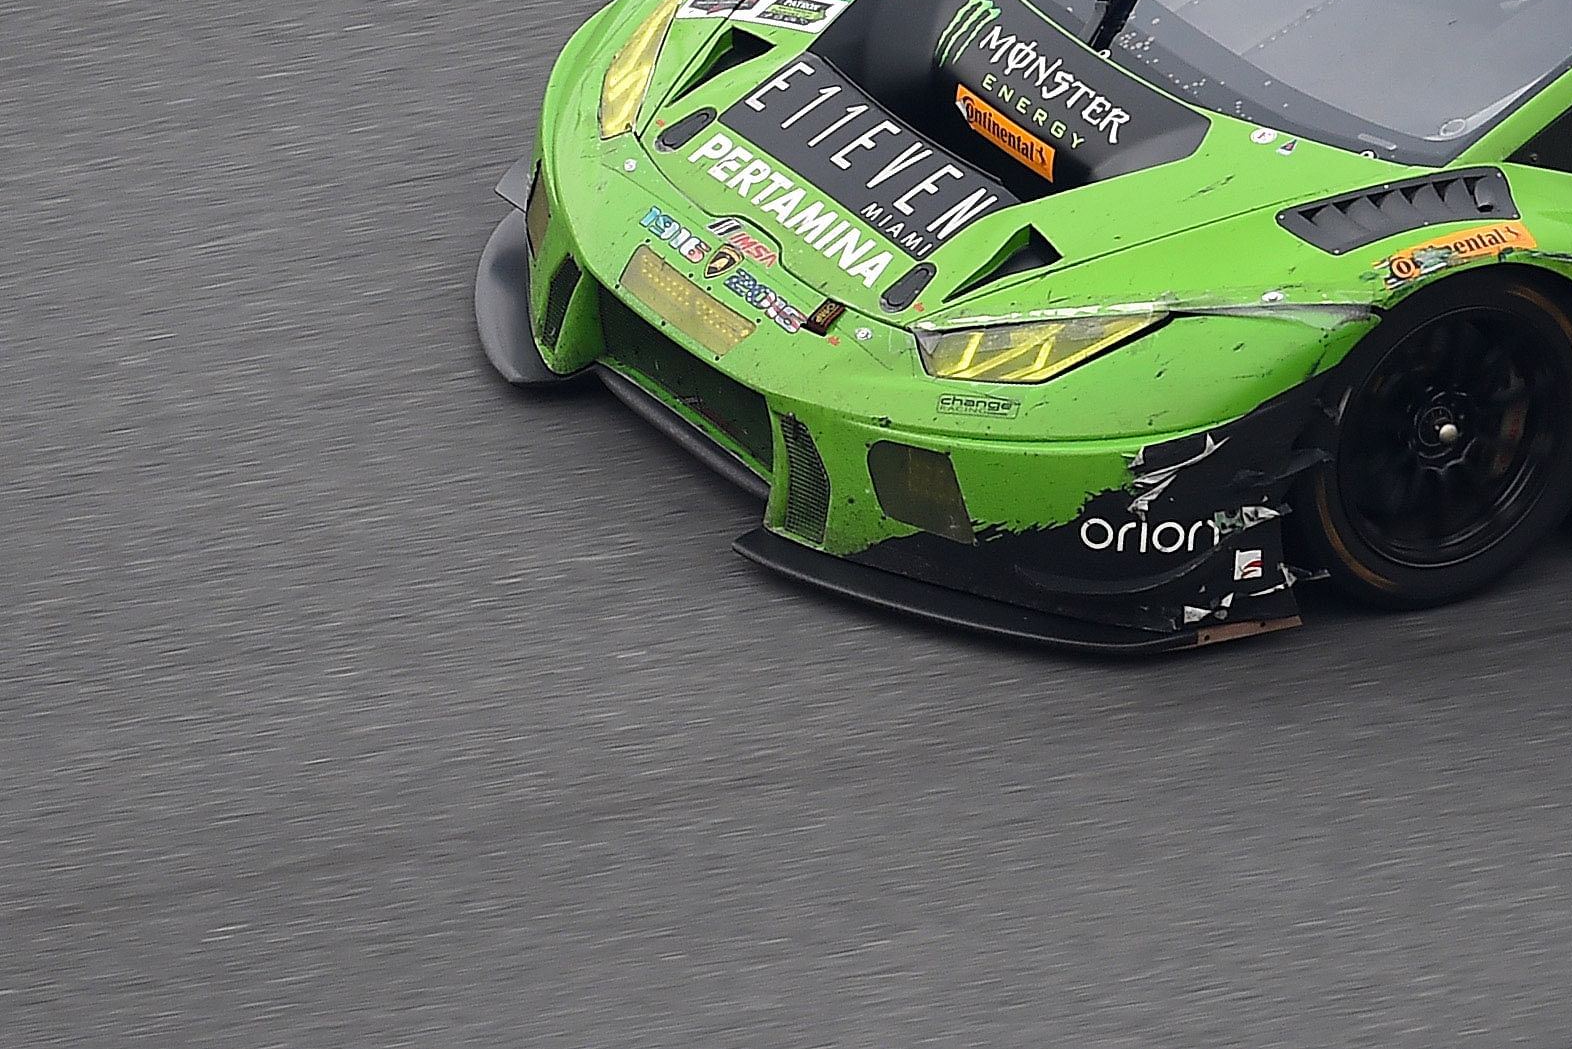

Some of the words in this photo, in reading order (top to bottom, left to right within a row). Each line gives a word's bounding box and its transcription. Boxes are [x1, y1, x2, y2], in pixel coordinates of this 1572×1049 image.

[981, 73, 1086, 149] ENERGY
[638, 205, 712, 263] 1916
[687, 132, 895, 288] PERTAMINA
[861, 202, 934, 257] MIAMI
[728, 231, 779, 269] IMSA
[723, 267, 809, 334] 2016
[940, 396, 1012, 412] change
